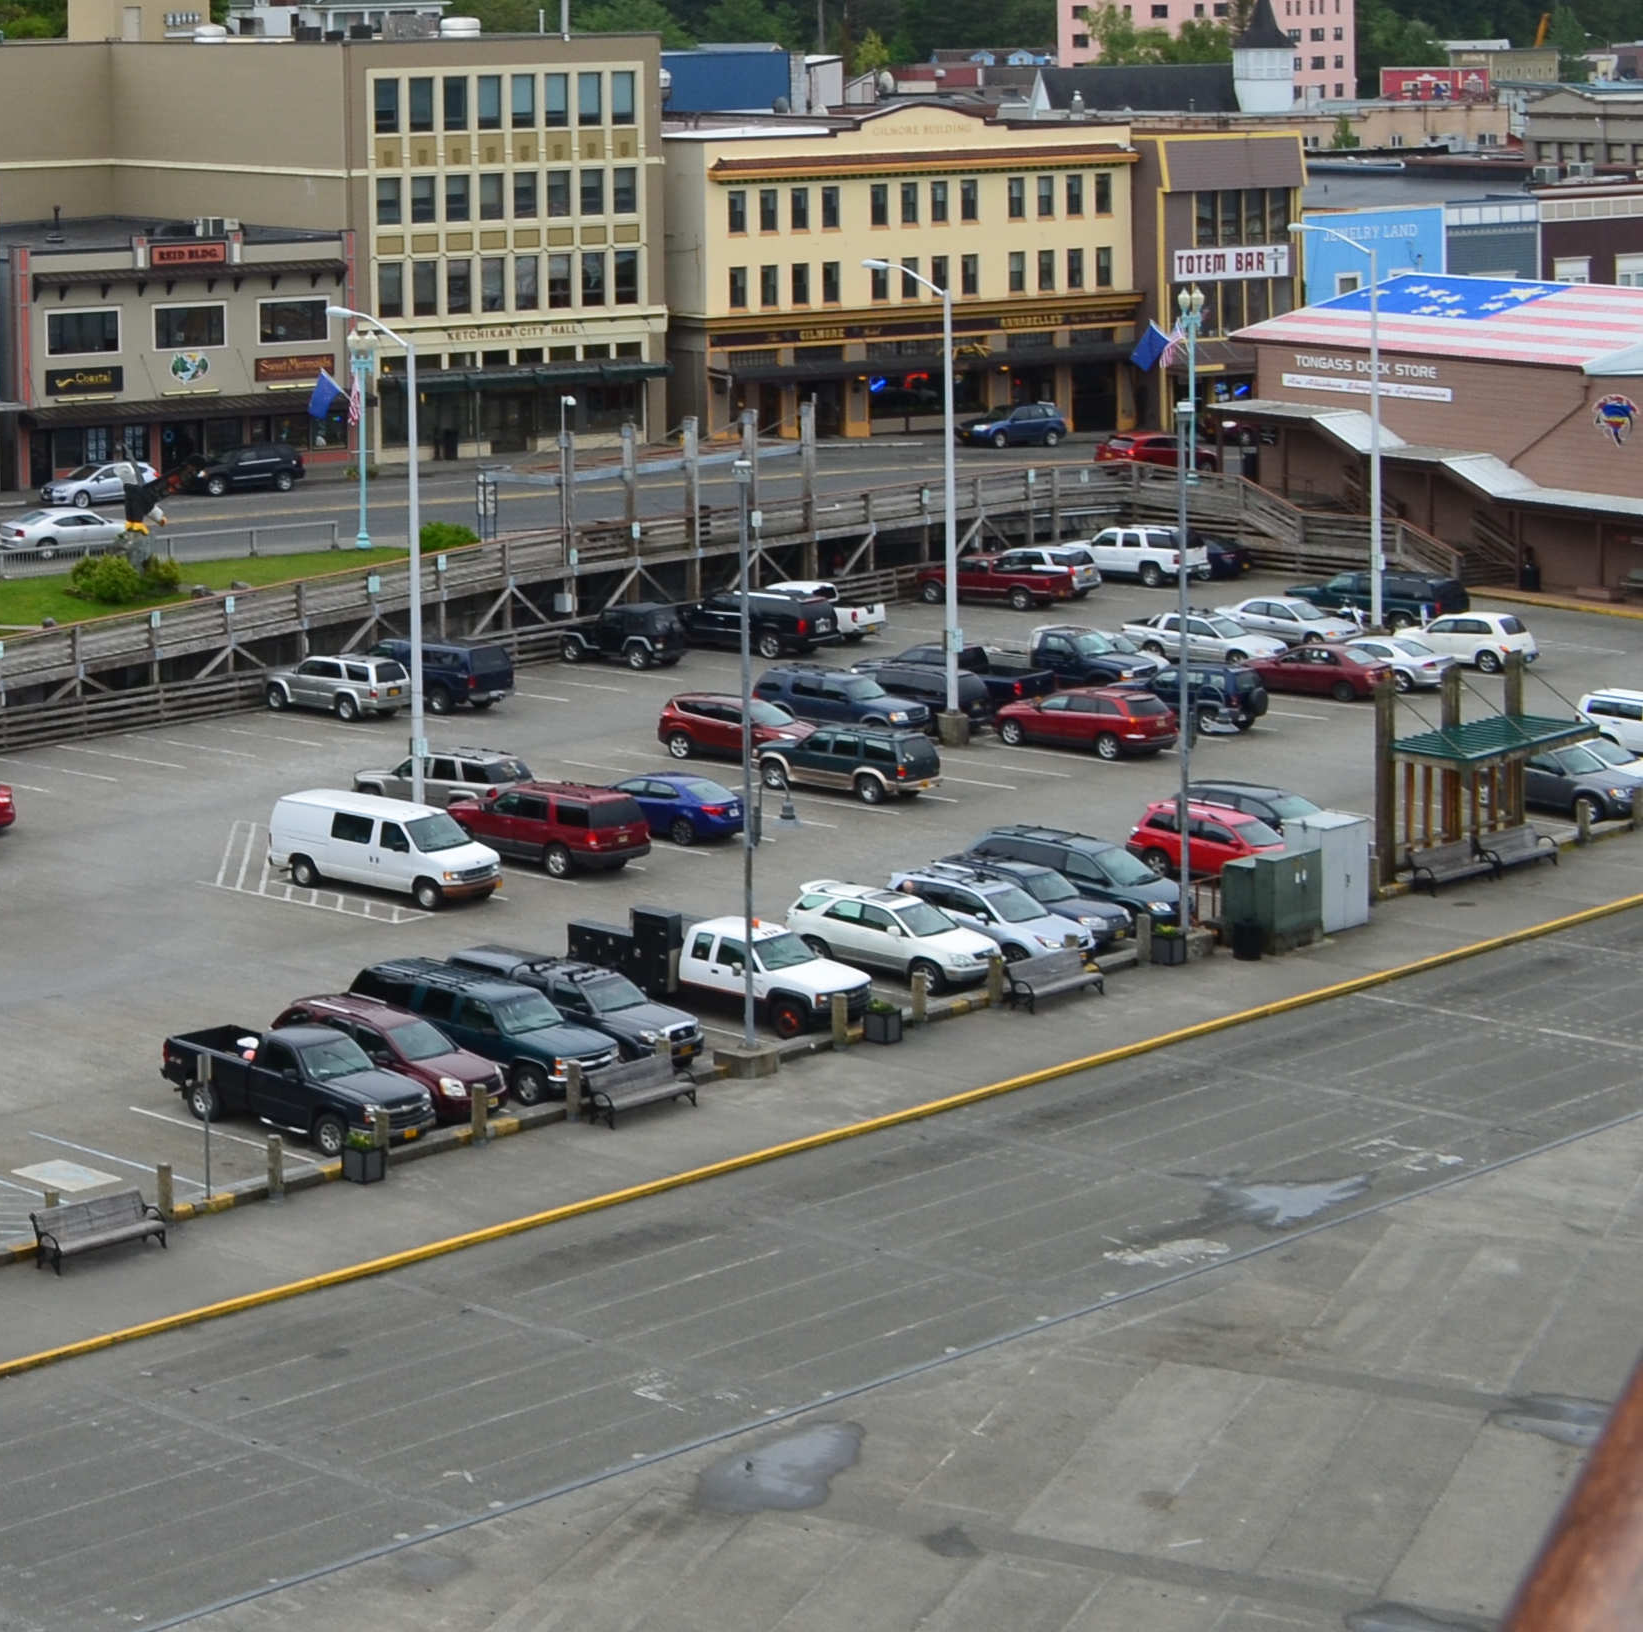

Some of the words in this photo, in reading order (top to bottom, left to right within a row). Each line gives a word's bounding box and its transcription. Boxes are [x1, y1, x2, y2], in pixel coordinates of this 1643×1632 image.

[872, 126, 919, 136] GILMORE
[923, 124, 972, 135] BUILDING
[1323, 226, 1379, 242] JEWELRY
[1383, 223, 1417, 238] LAND
[158, 251, 185, 261] REID
[1177, 254, 1226, 275] TOTEM
[1235, 251, 1265, 273] BAR
[447, 328, 512, 341] KETCHIKAN
[520, 326, 545, 337] CITY
[551, 324, 578, 335] HALL
[799, 329, 845, 340] GILMORE
[1295, 354, 1353, 372] TONGASS
[1395, 363, 1437, 379] STORE
